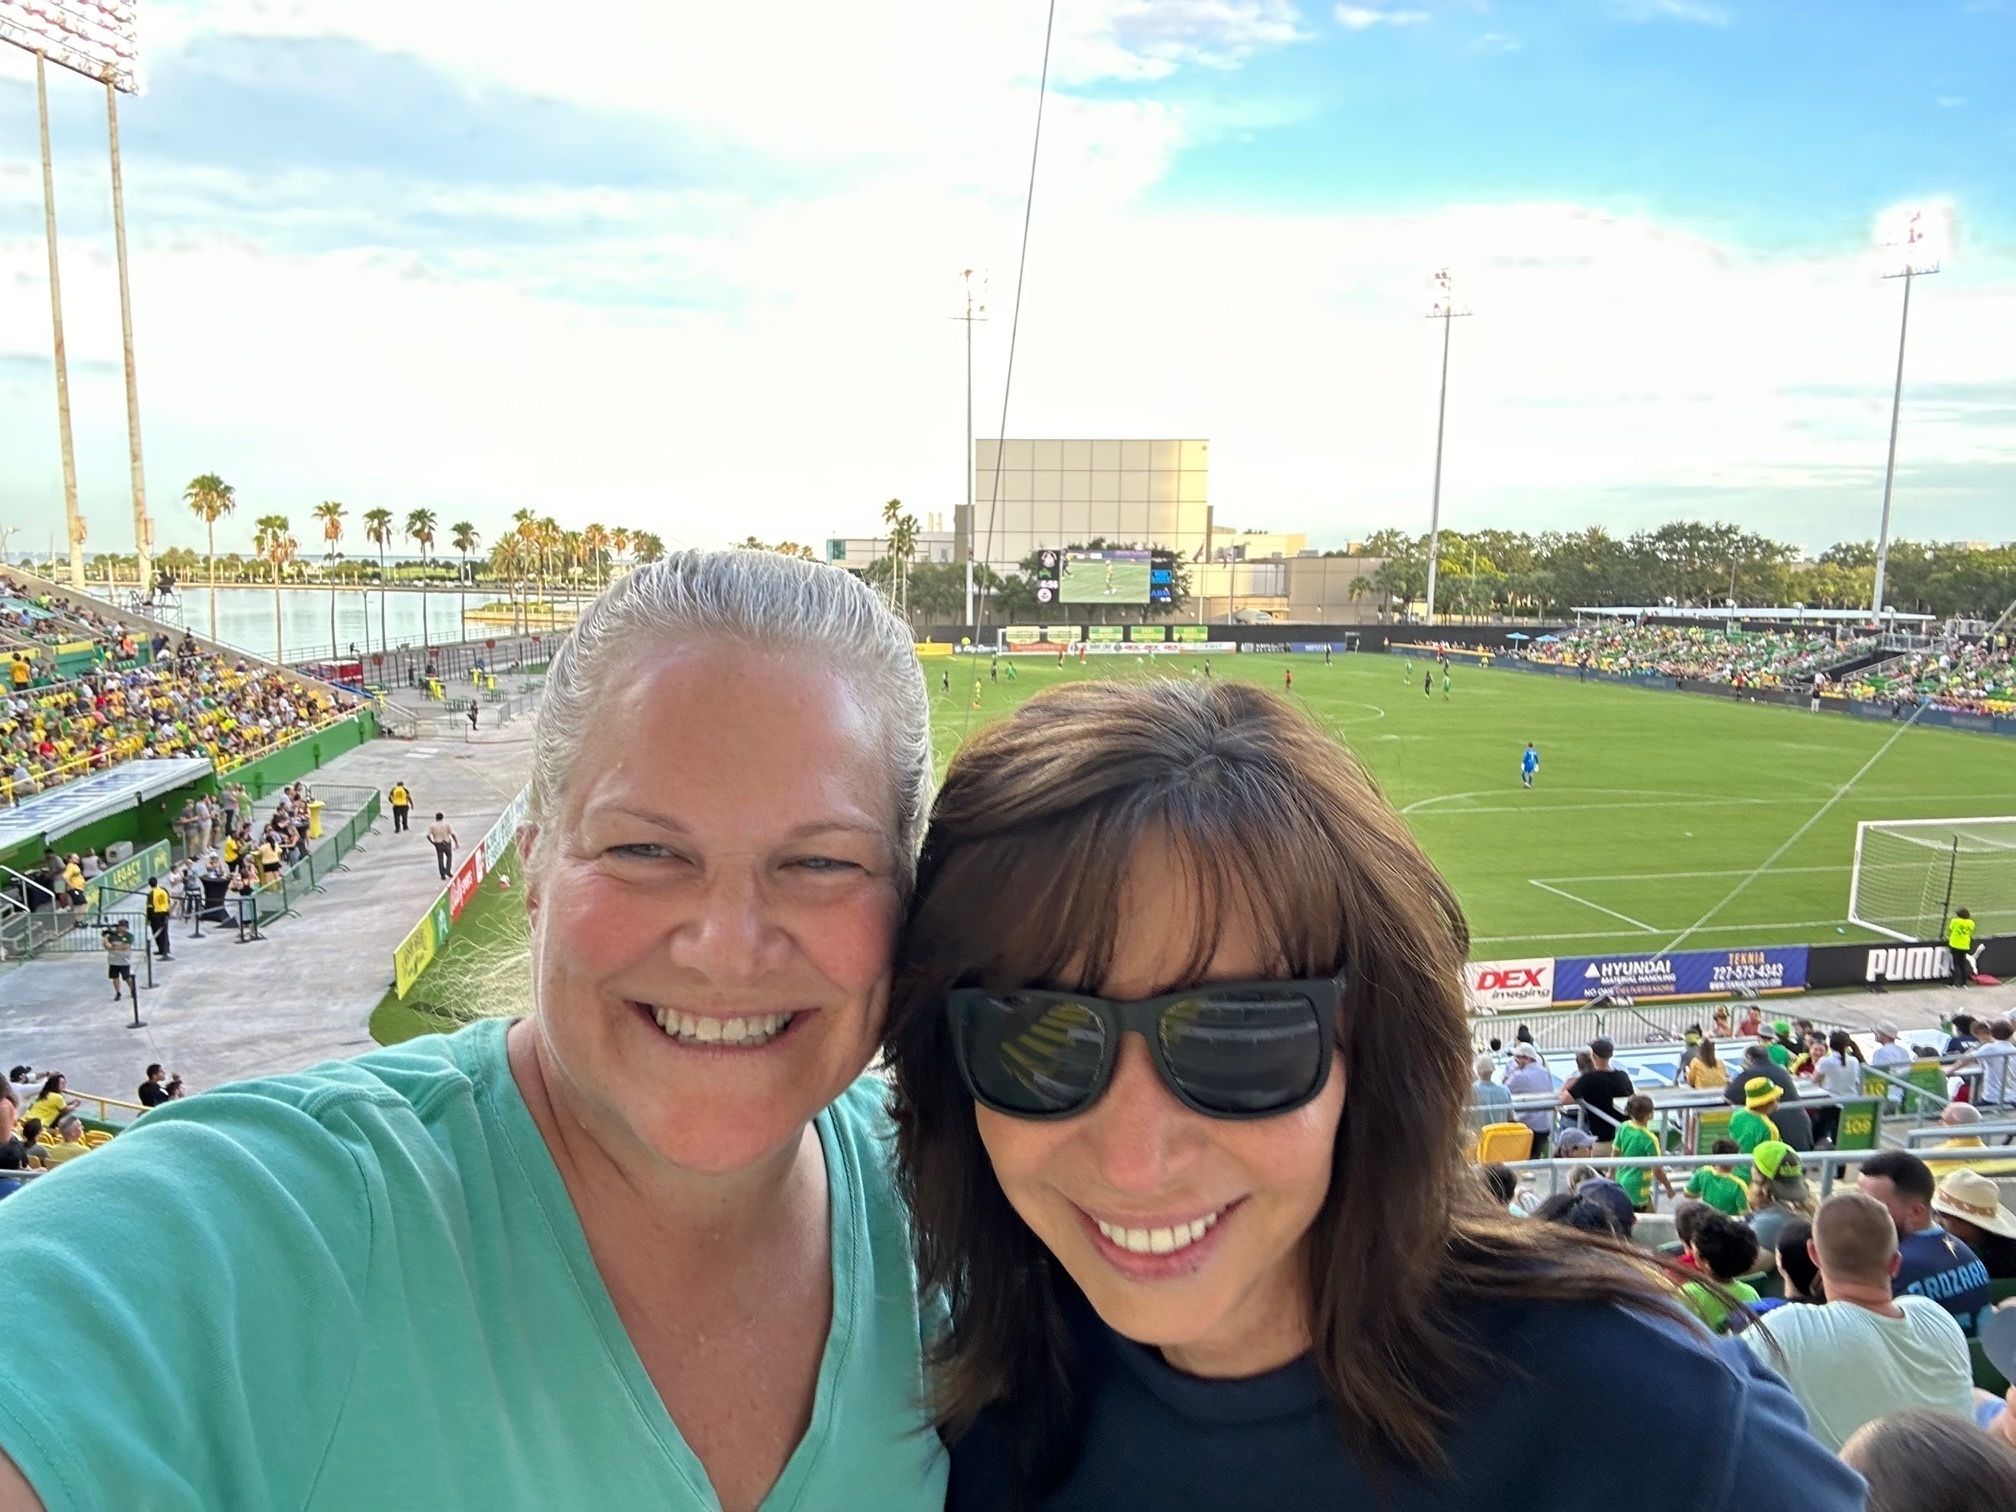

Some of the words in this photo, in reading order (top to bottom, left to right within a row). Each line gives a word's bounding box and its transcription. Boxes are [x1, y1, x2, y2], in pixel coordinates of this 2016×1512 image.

[1601, 960, 1672, 977] HYUNDAI
[1866, 946, 1955, 982] PUMA
[1476, 967, 1547, 991] DEX
[1491, 986, 1551, 1000] imaging
